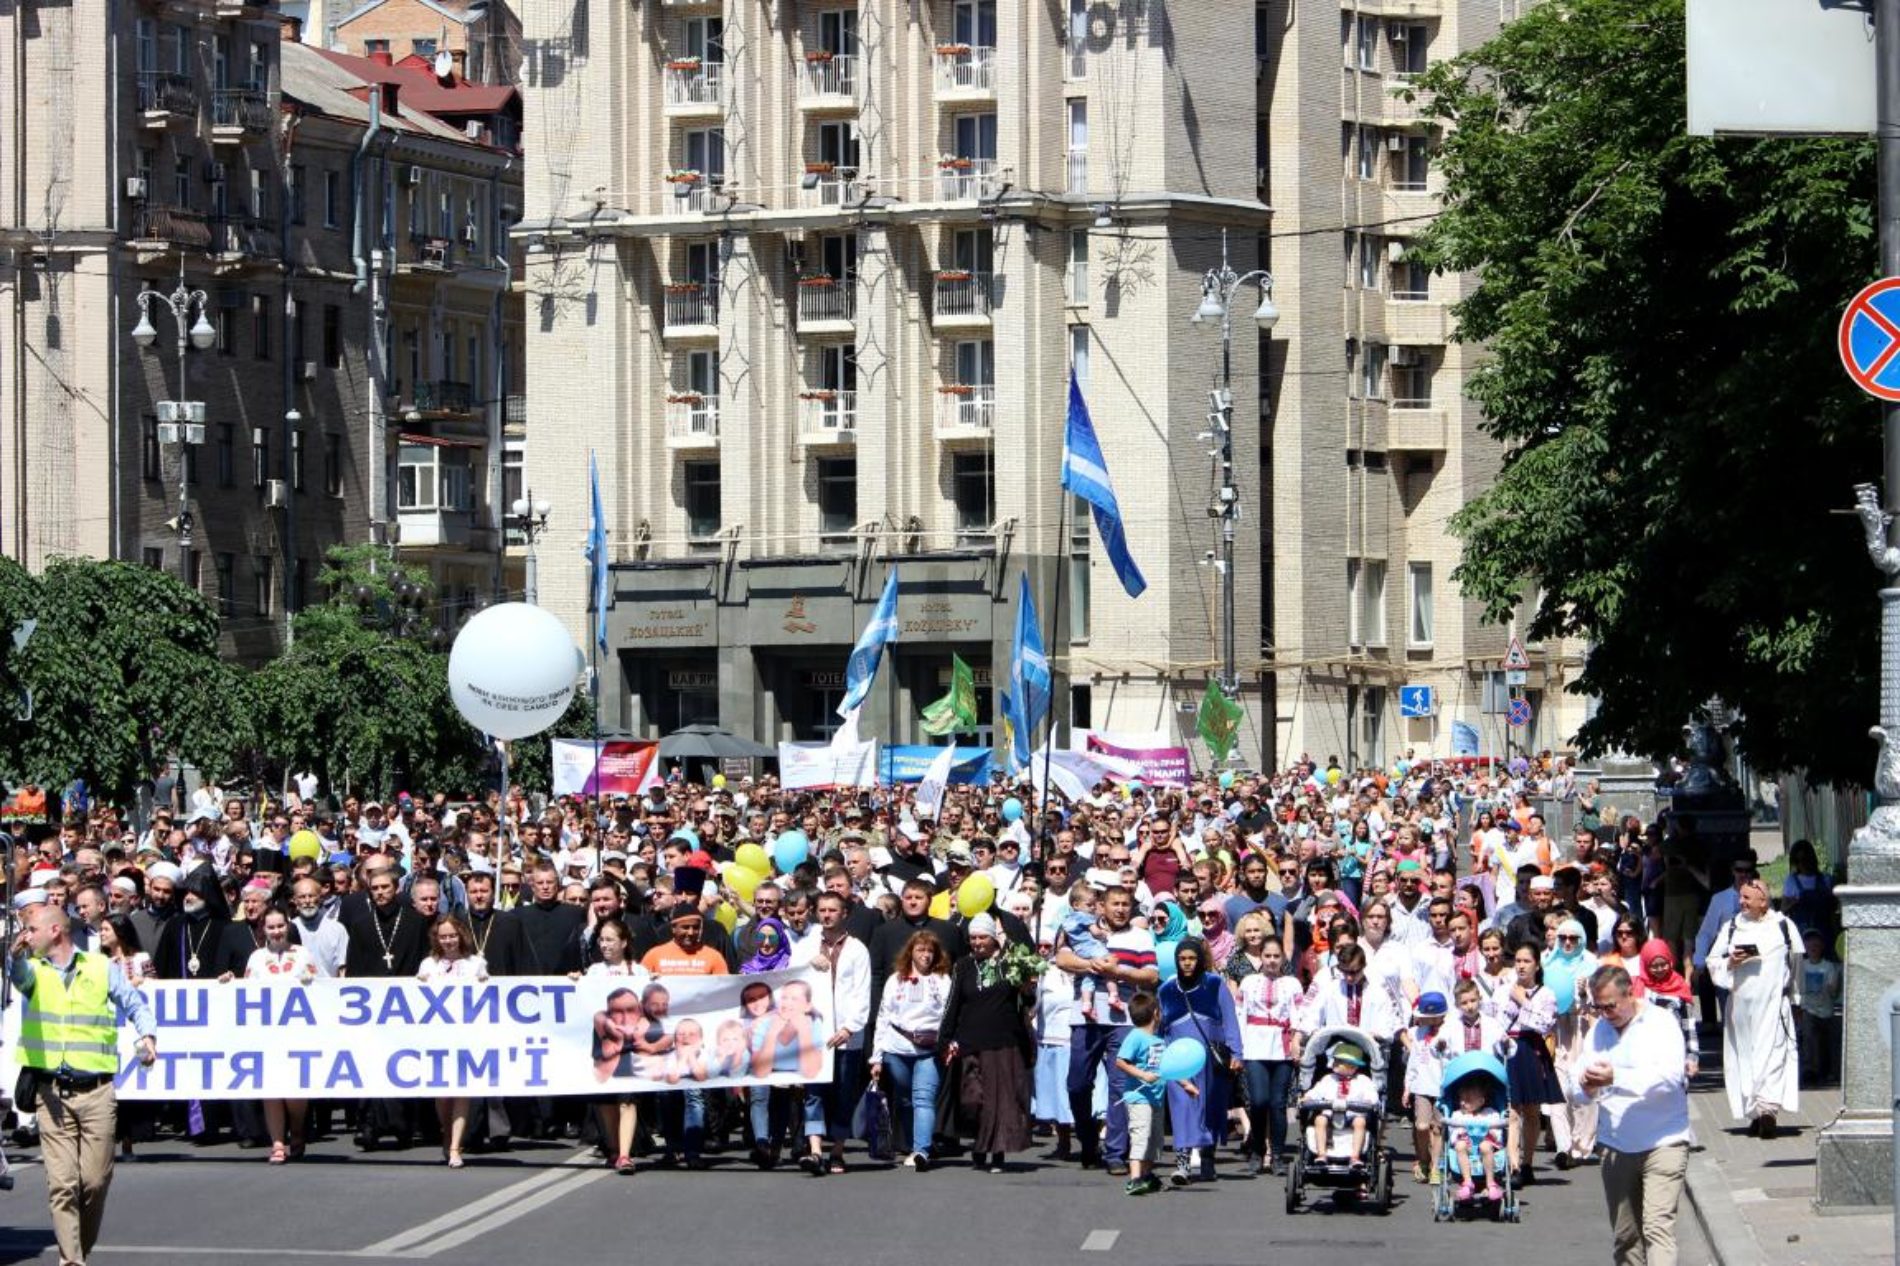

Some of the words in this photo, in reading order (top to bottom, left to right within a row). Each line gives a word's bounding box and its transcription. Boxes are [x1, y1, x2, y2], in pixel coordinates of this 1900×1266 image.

[235, 987, 317, 1026] НА
[338, 984, 576, 1026] ЗАХИСТ
[288, 1049, 363, 1090] ТА
[385, 1036, 549, 1089] СІМ'Ї
